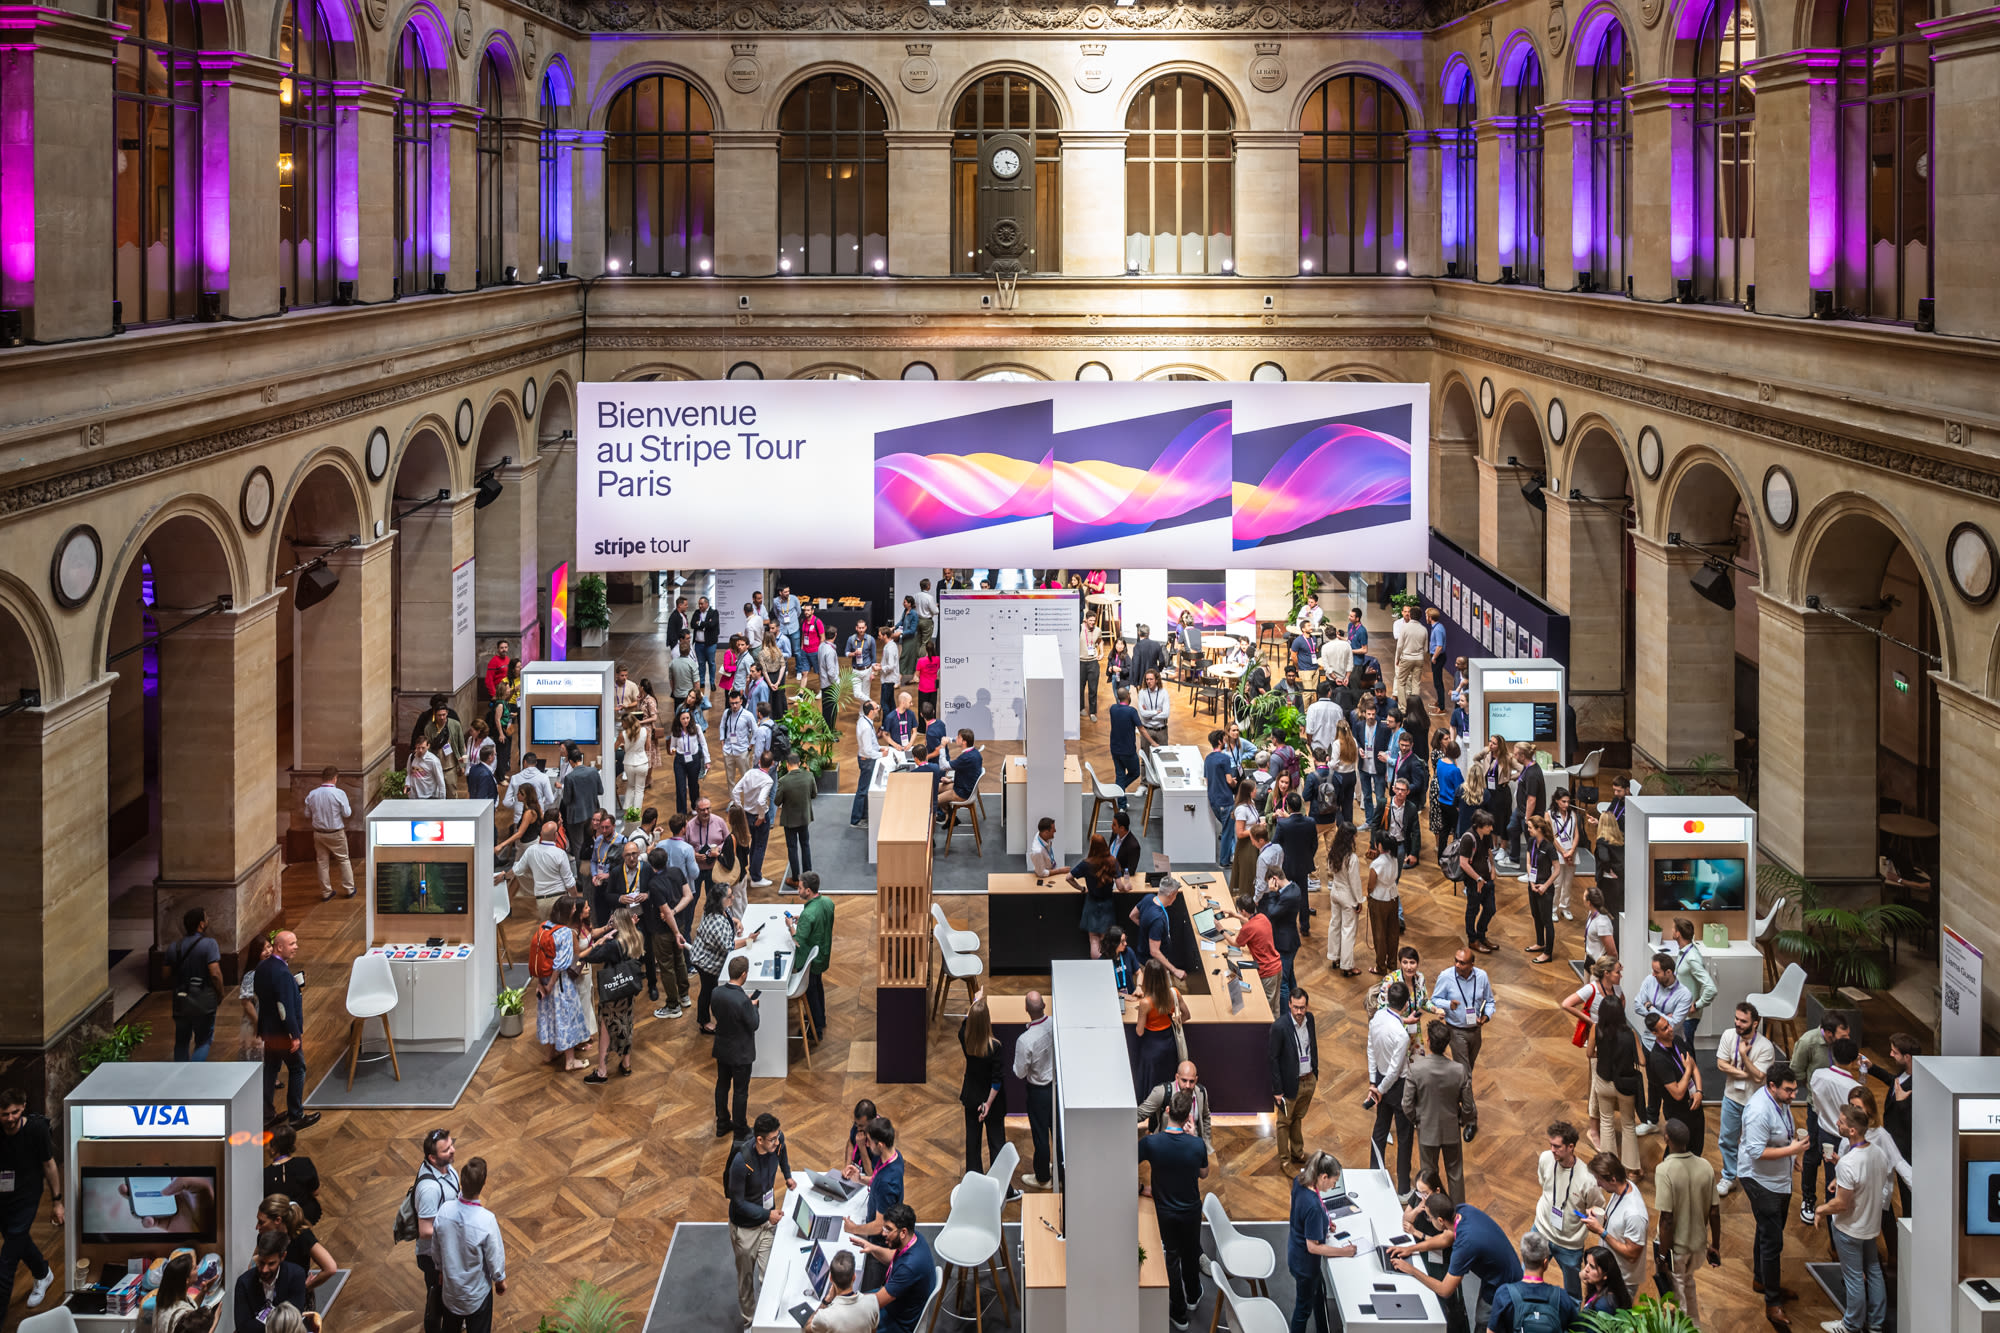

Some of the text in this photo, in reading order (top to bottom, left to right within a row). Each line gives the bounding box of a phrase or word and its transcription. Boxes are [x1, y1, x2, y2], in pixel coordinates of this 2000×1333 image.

[597, 400, 757, 428] Bienvenue
[596, 432, 807, 467] au Stripe Tour
[597, 470, 672, 498] Paris
[594, 536, 691, 558] stripe tour
[944, 608, 964, 616] Etage
[944, 701, 964, 709] Etage
[603, 980, 619, 990] TOTE
[619, 975, 634, 984] BAG
[613, 972, 624, 981] THE
[1960, 968, 1976, 985] Guest
[127, 1105, 189, 1126] VISA
